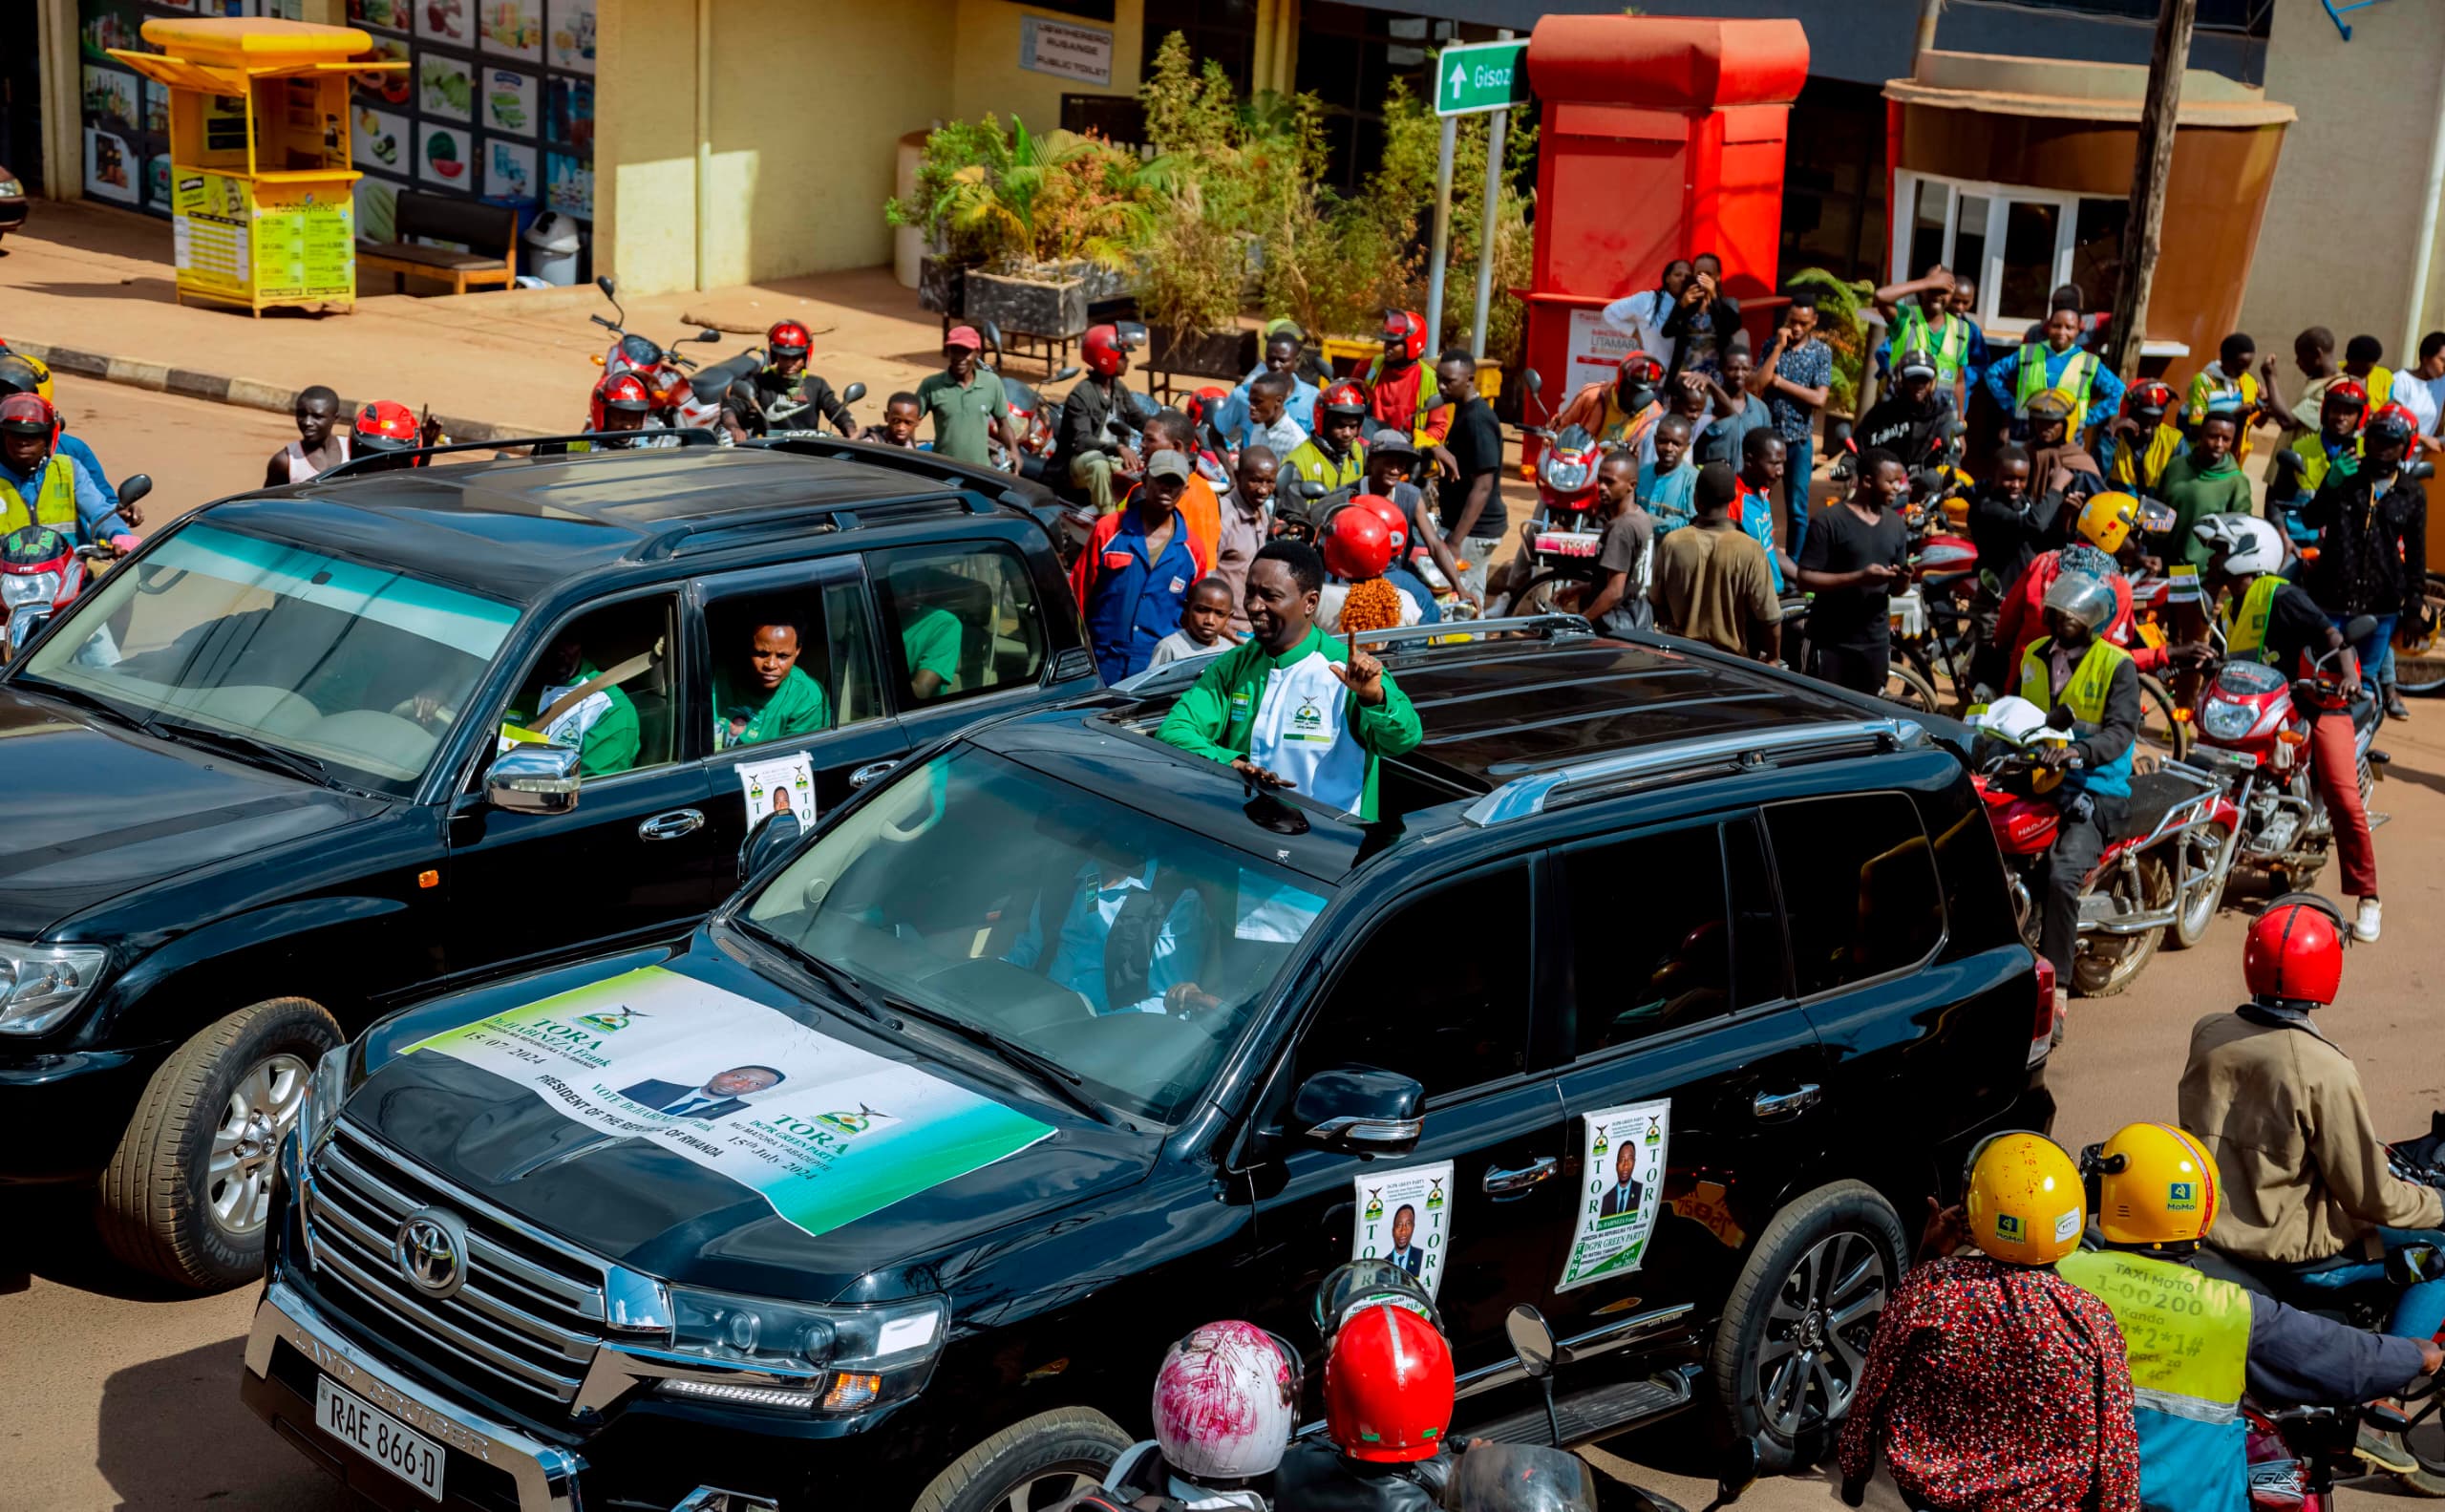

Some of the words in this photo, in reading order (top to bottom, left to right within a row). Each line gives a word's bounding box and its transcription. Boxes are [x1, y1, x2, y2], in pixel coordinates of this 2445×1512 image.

[1036, 54, 1072, 70] PUBLIC
[1073, 62, 1108, 77] TOILET
[1475, 64, 1514, 89] Gisoz
[532, 1017, 604, 1051] TORA
[572, 1048, 612, 1068] Frank
[590, 1081, 623, 1104] VOTE
[535, 1074, 591, 1111] PRESIDENT
[585, 1107, 605, 1117] OF
[599, 1113, 622, 1126] THE
[664, 1128, 683, 1139] OF
[678, 1133, 725, 1159] RWANDA
[742, 1126, 779, 1147] MATORA
[773, 1113, 849, 1156] TORA
[776, 1130, 808, 1148] GREEN
[806, 1145, 839, 1162] PARTY
[751, 1147, 781, 1164] July
[781, 1161, 819, 1181] 2024
[1584, 1159, 1605, 1233] TORA
[1638, 1148, 1660, 1222] TORA
[2167, 1203, 2196, 1212] MoMo
[1422, 1212, 1443, 1288] TORA
[1603, 1236, 1625, 1248] GREEN
[1625, 1230, 1645, 1243] PARTY
[1996, 1231, 2024, 1244] MoMo
[2115, 1262, 2148, 1283] TAXI
[2151, 1274, 2195, 1293] MOTO
[2120, 1306, 2165, 1326] Kanda
[2166, 1359, 2182, 1368] za
[294, 1328, 355, 1383] LAND
[368, 1380, 490, 1460] CRUISER
[330, 1393, 372, 1451] RAE
[376, 1421, 417, 1476] 866
[421, 1448, 436, 1488] D
[2252, 1470, 2302, 1492] GLX
